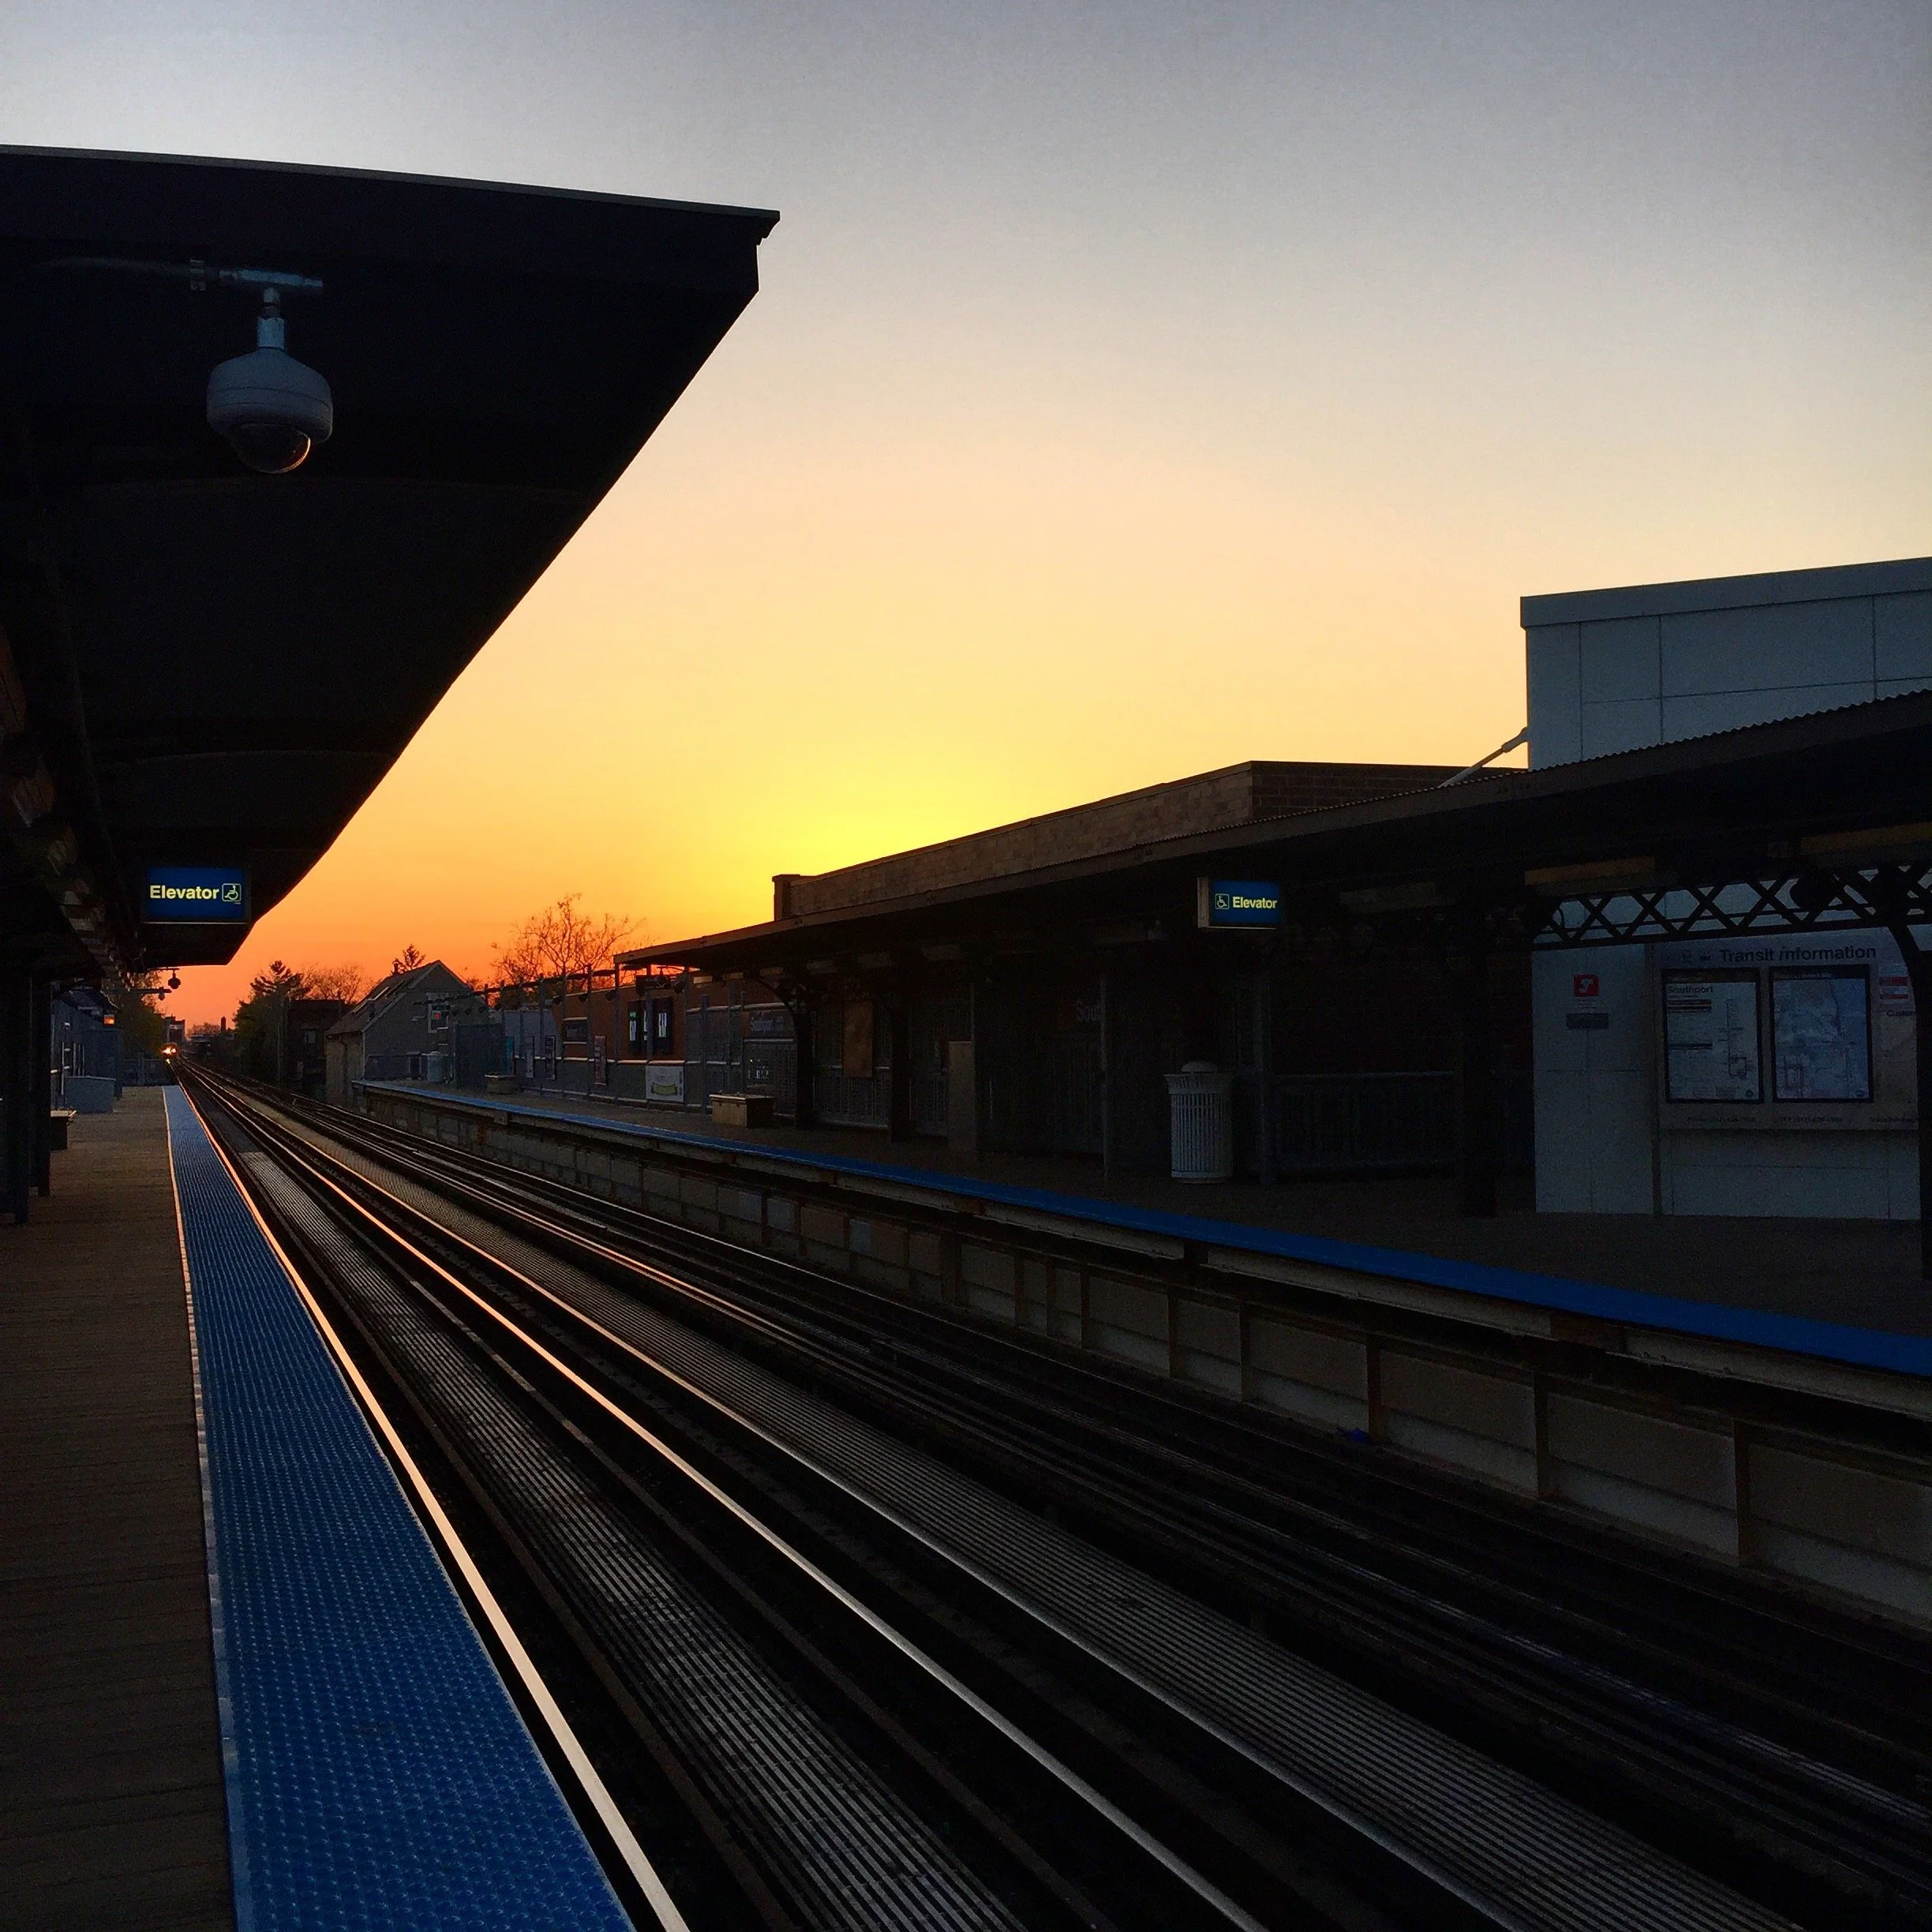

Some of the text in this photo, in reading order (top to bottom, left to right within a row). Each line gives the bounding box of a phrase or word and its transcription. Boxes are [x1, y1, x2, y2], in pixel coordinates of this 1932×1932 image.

[150, 885, 219, 899] Elevator
[1232, 897, 1279, 909] Elevator
[1720, 945, 1877, 963] Transit information
[1667, 985, 1713, 995] Southport
